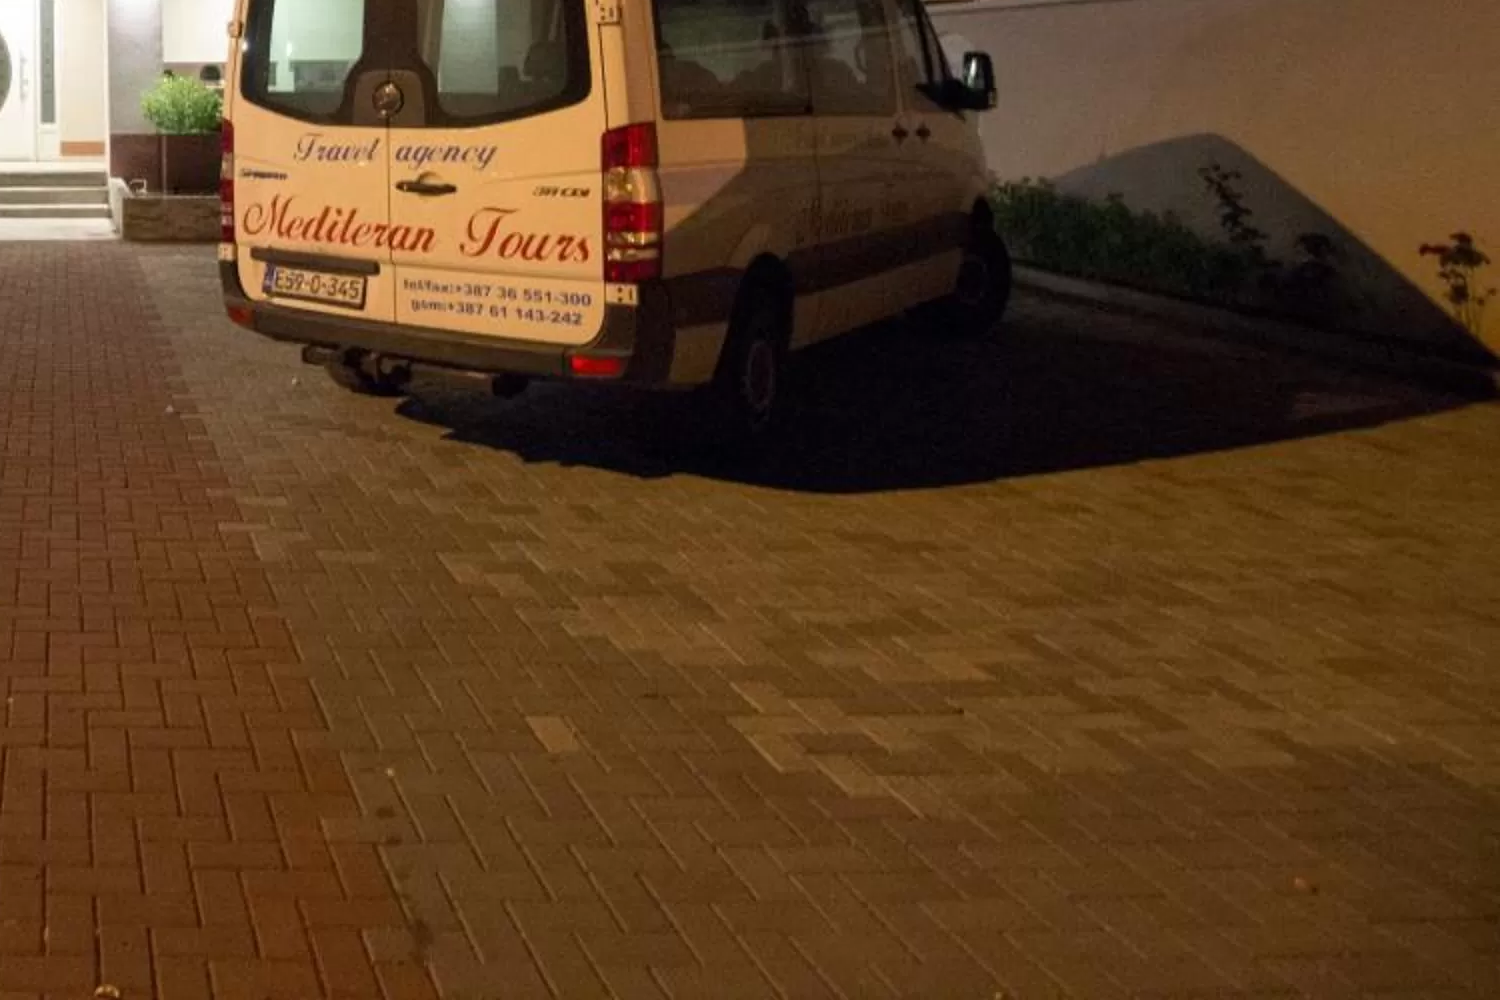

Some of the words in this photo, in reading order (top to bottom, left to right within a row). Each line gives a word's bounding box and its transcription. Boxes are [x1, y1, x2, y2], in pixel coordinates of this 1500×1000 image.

[293, 131, 381, 163] Travel
[395, 143, 498, 171] agency
[459, 206, 591, 264] Tours
[523, 288, 592, 307] 551-300
[490, 304, 508, 319] 61
[516, 307, 583, 326] 143-242
